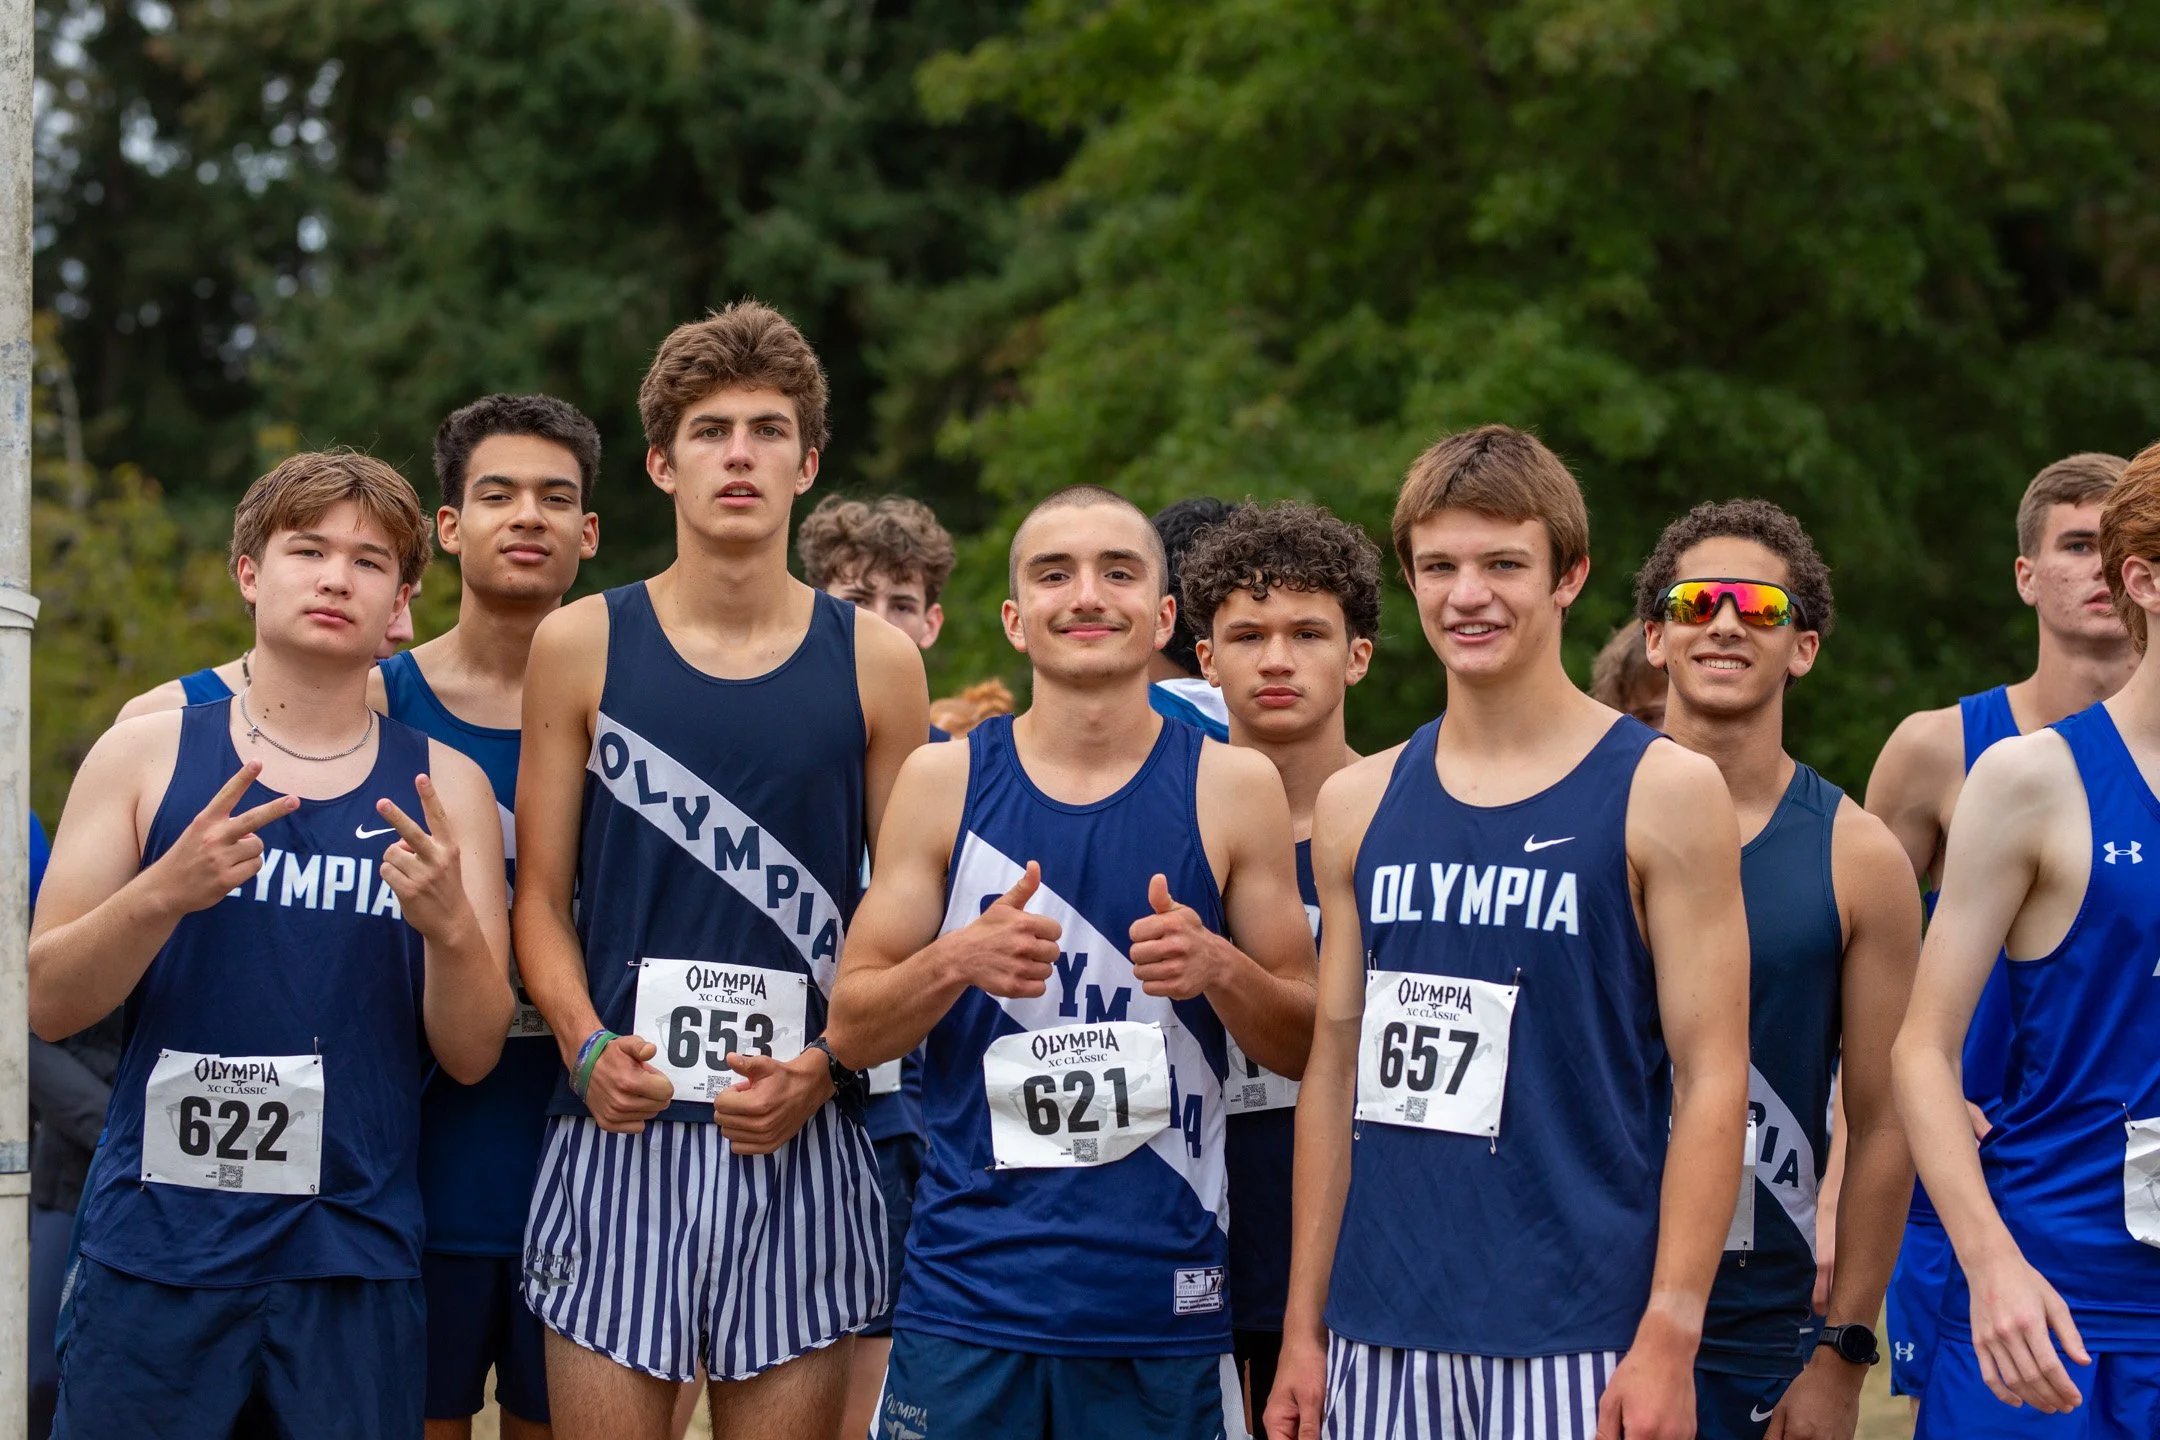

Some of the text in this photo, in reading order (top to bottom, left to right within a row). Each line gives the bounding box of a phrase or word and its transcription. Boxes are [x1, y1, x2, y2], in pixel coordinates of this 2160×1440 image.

[599, 731, 839, 963] OLYMPIA
[226, 847, 402, 921] YMPIA
[1370, 862, 1579, 936] OLYMPIA
[685, 964, 768, 1001] OLYMPIA
[698, 993, 757, 1007] XC CLASSIC
[1397, 977, 1473, 1015] OLYMPIA
[1405, 1007, 1461, 1022] XC CLASSIC
[667, 1005, 774, 1072] 653
[1031, 1026, 1120, 1062] OLYMPIA
[194, 1056, 280, 1088] OLYMPIA
[1048, 1053, 1109, 1068] XC CLASSIC
[1379, 1021, 1480, 1096] 657
[206, 1084, 268, 1096] XC CLASSIC
[1022, 1066, 1131, 1136] 621
[178, 1095, 290, 1162] 622
